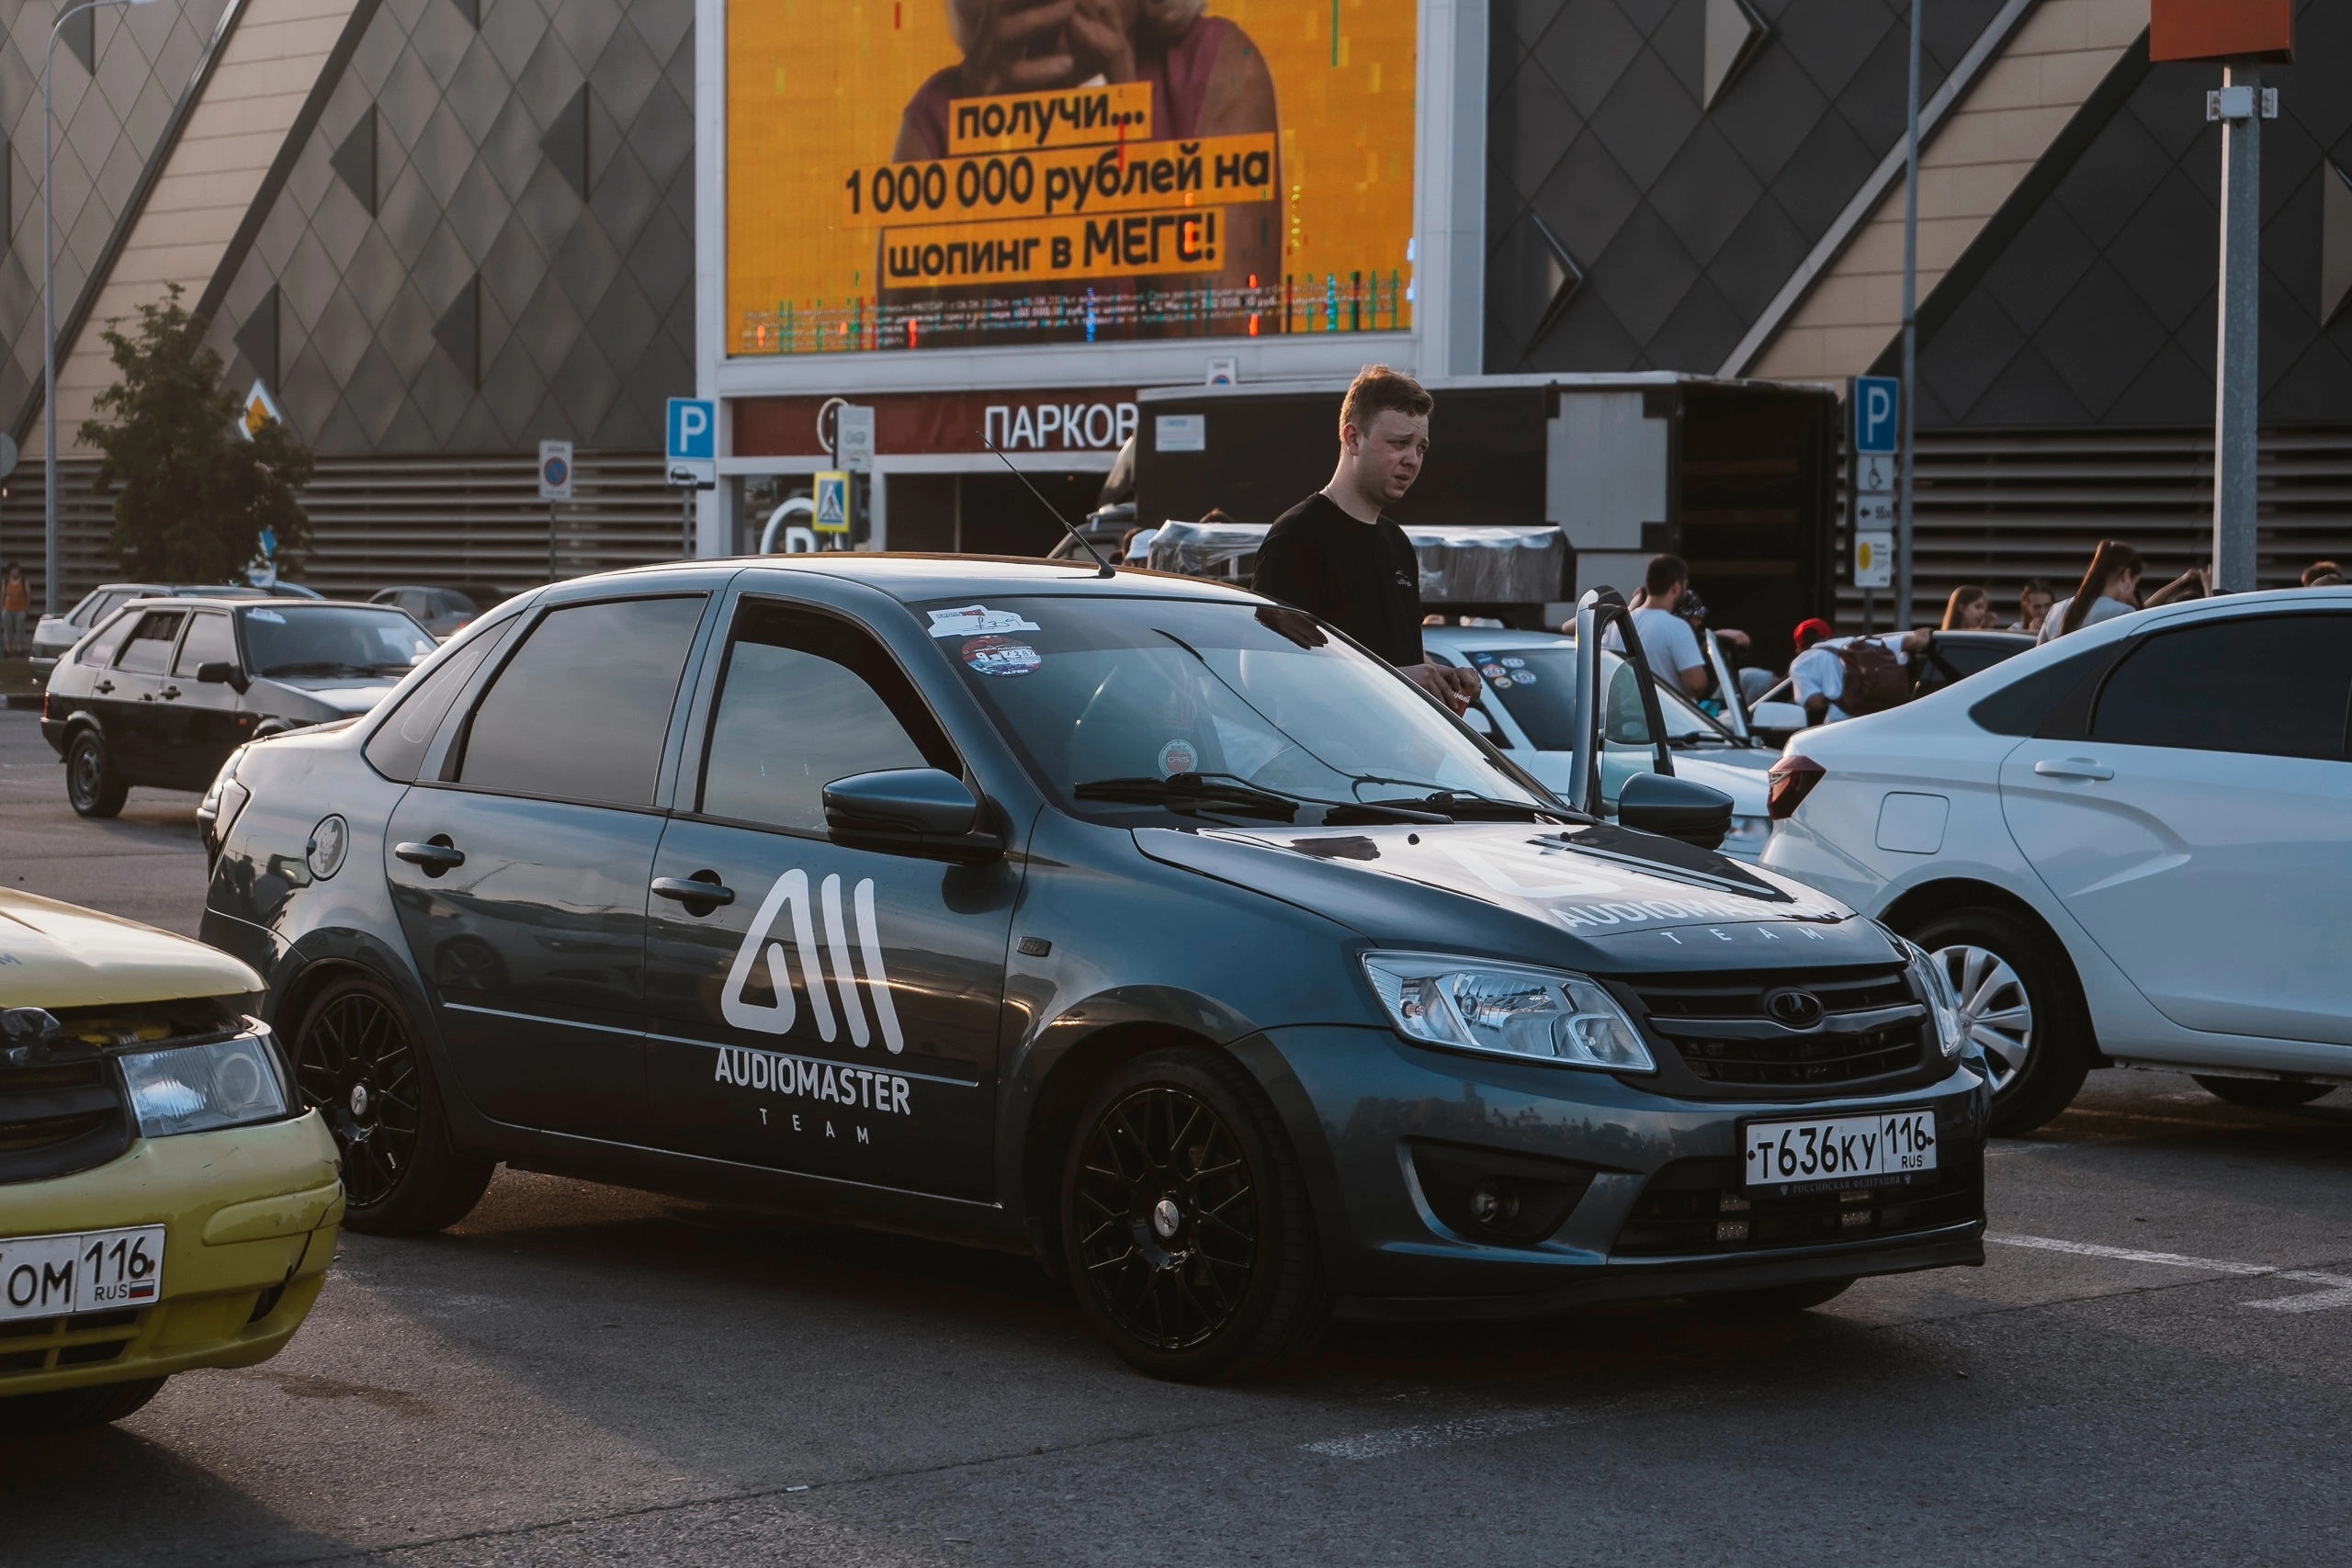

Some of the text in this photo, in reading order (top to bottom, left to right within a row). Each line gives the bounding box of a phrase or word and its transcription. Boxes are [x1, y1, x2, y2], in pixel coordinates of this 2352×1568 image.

[956, 95, 1145, 143] получи...
[845, 143, 1270, 215] 1 000 000 рублей на
[888, 236, 1041, 277] шопинг
[1050, 237, 1073, 269] в
[680, 405, 707, 453] P
[1868, 386, 1890, 444] P
[1660, 927, 1825, 945] TEAM
[716, 1047, 910, 1115] AUDIOMASTER
[760, 1108, 869, 1145] TEAM
[1884, 1115, 1928, 1155] 116
[1901, 1154, 1923, 1169] RUS
[1792, 1175, 1901, 1194] РОССИЙСКАЯ ФЕДЕРАЦИЯ
[0, 1235, 149, 1306] ОМ 116
[95, 1284, 128, 1302] RUS
